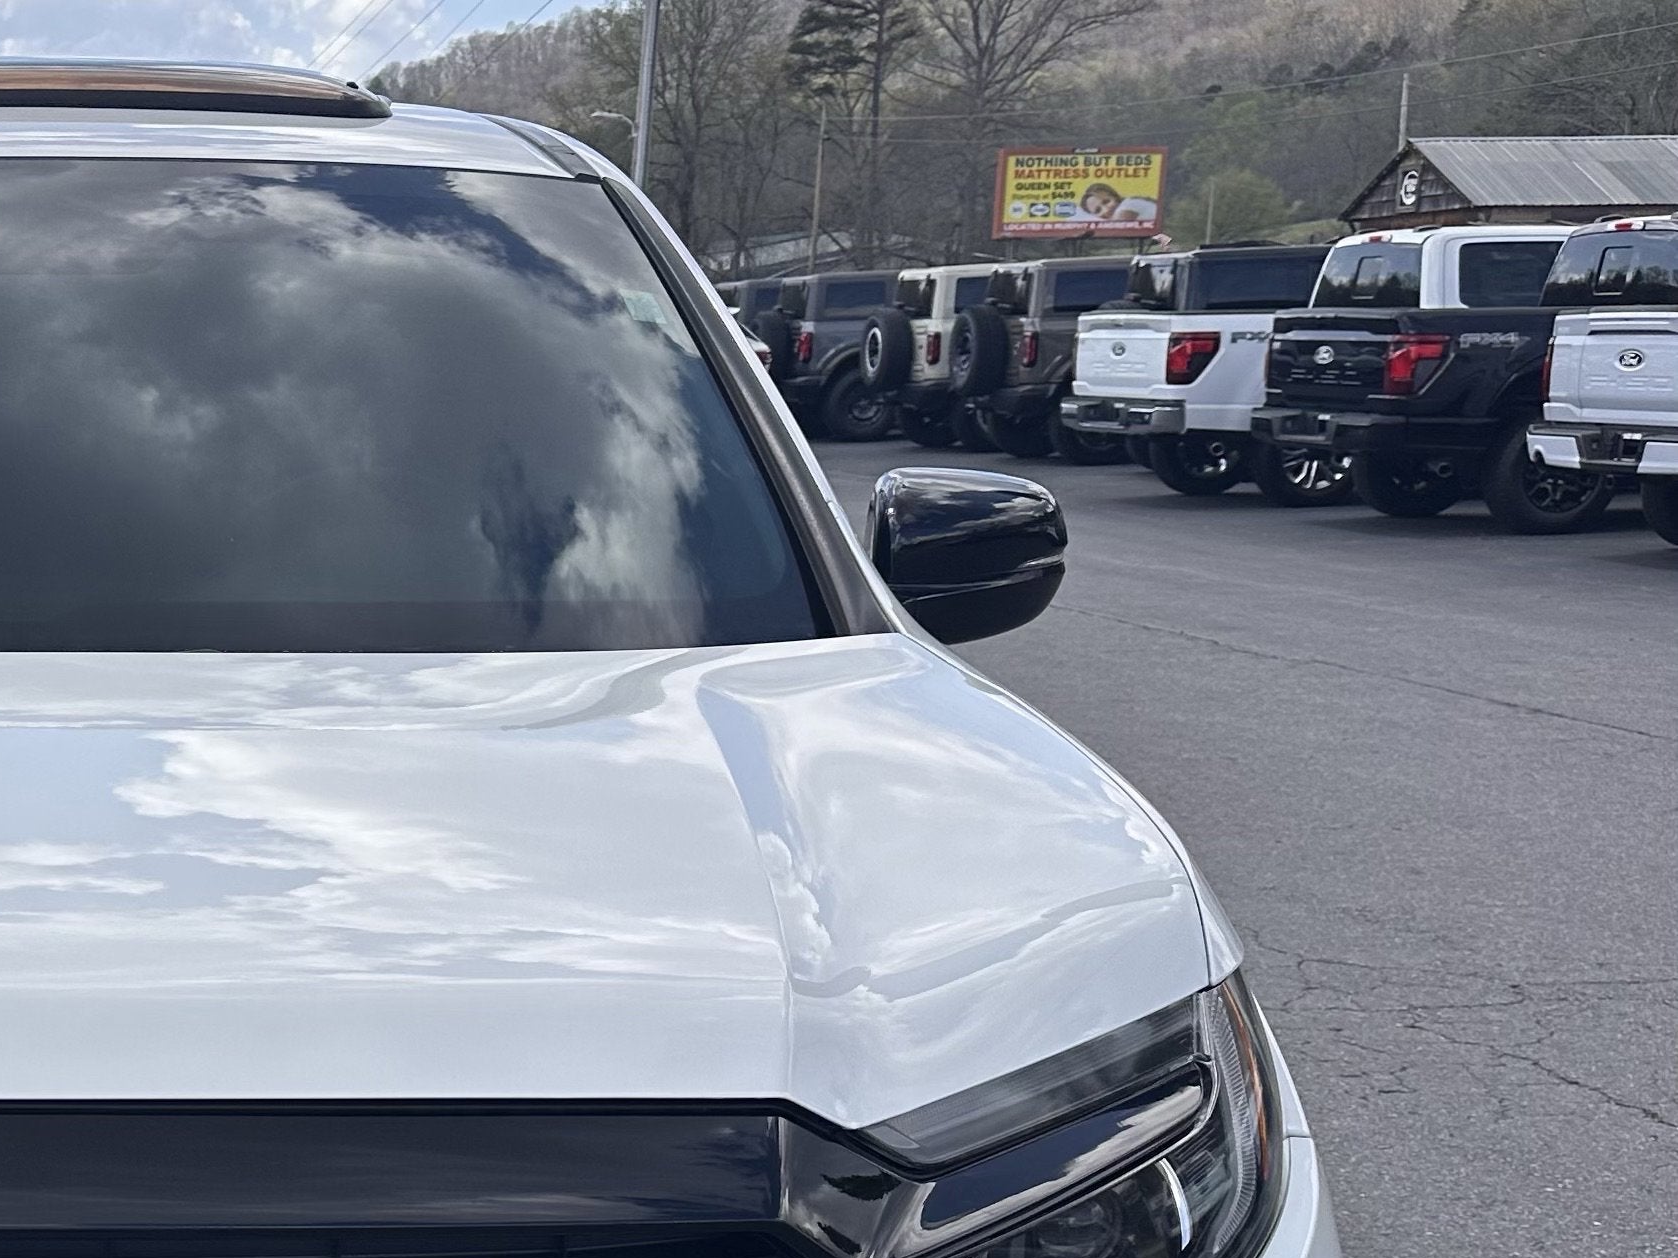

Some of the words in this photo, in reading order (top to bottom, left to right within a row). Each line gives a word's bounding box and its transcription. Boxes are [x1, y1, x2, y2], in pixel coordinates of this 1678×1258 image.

[1015, 157, 1079, 168] NOTHING
[1083, 156, 1110, 167] BUT
[1115, 155, 1152, 166] BEDS
[1014, 168, 1090, 179] MATTRESS
[1094, 167, 1151, 178] OUTLET
[1015, 182, 1051, 191] QUEEN
[1053, 181, 1073, 190] SET
